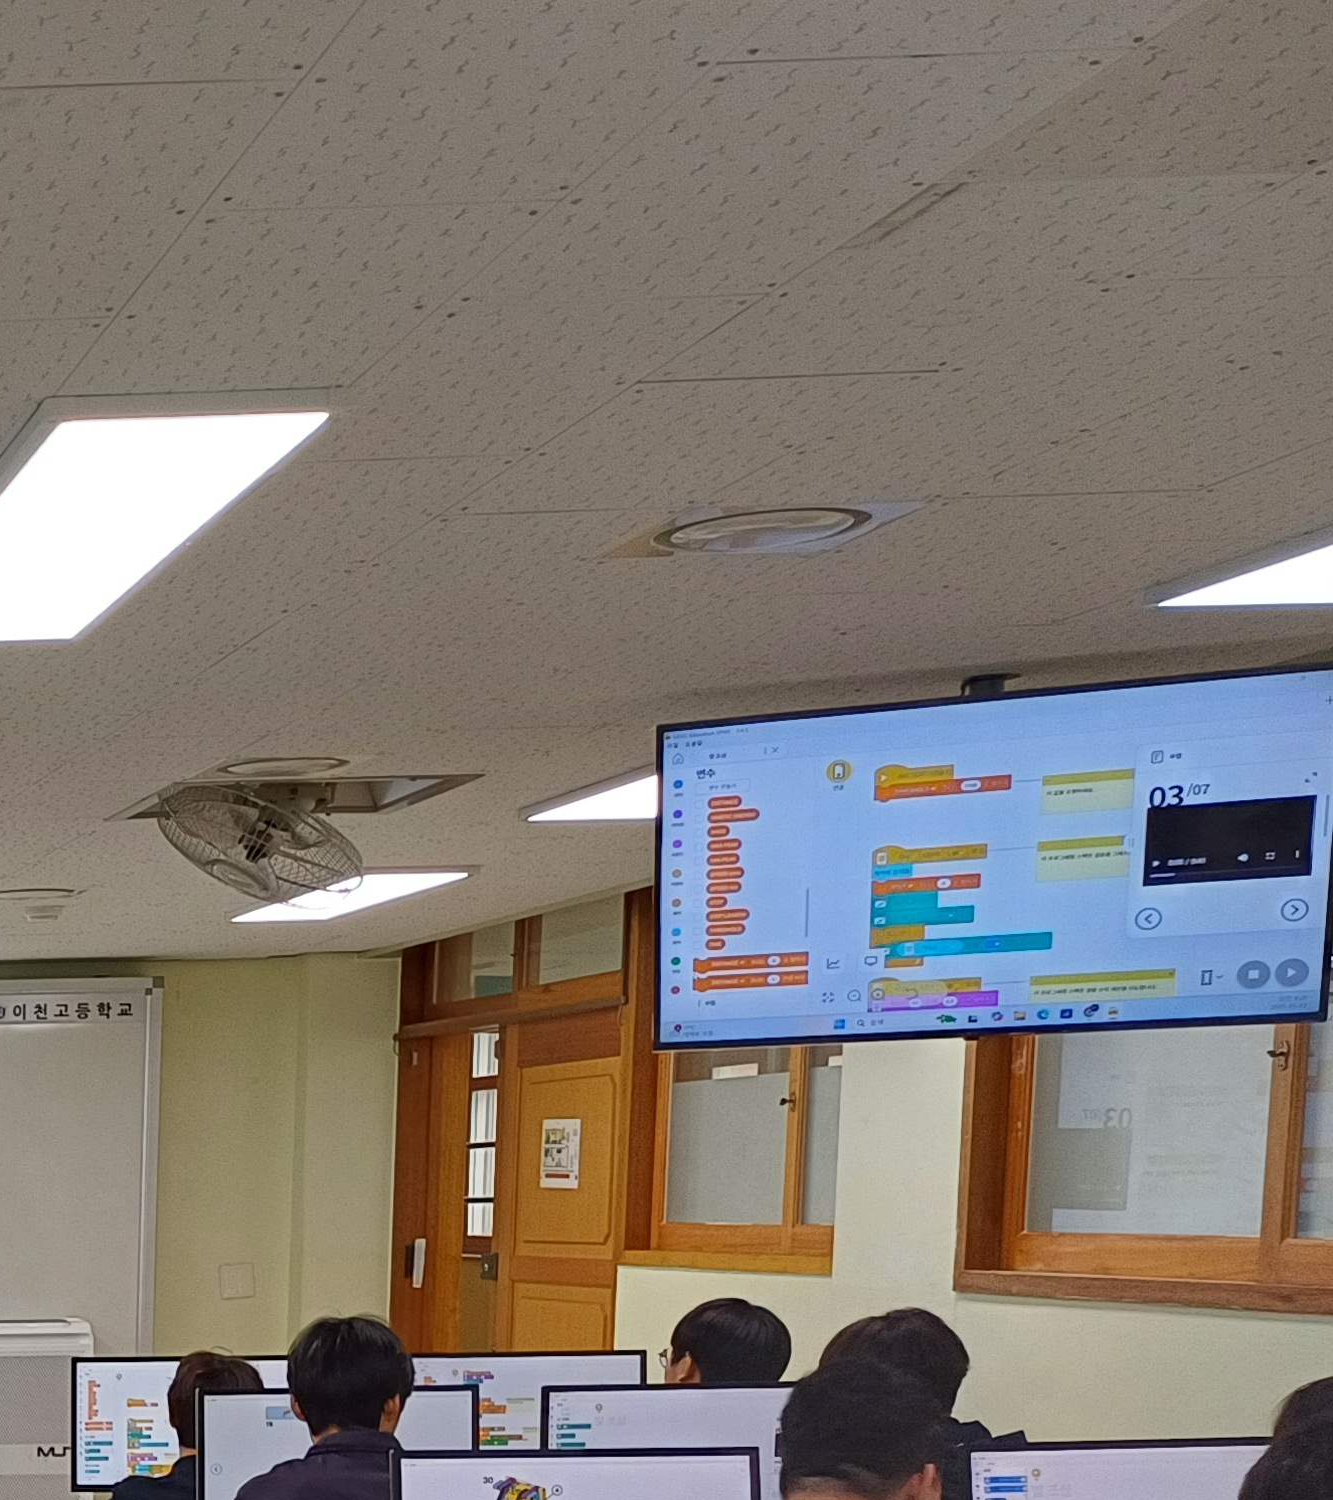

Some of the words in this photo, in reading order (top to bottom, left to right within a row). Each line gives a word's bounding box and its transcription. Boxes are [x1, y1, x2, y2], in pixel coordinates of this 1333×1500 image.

[1149, 785, 1184, 808] 03
[12, 1002, 134, 1021] 이천고등학교
[482, 1476, 494, 1484] 30
